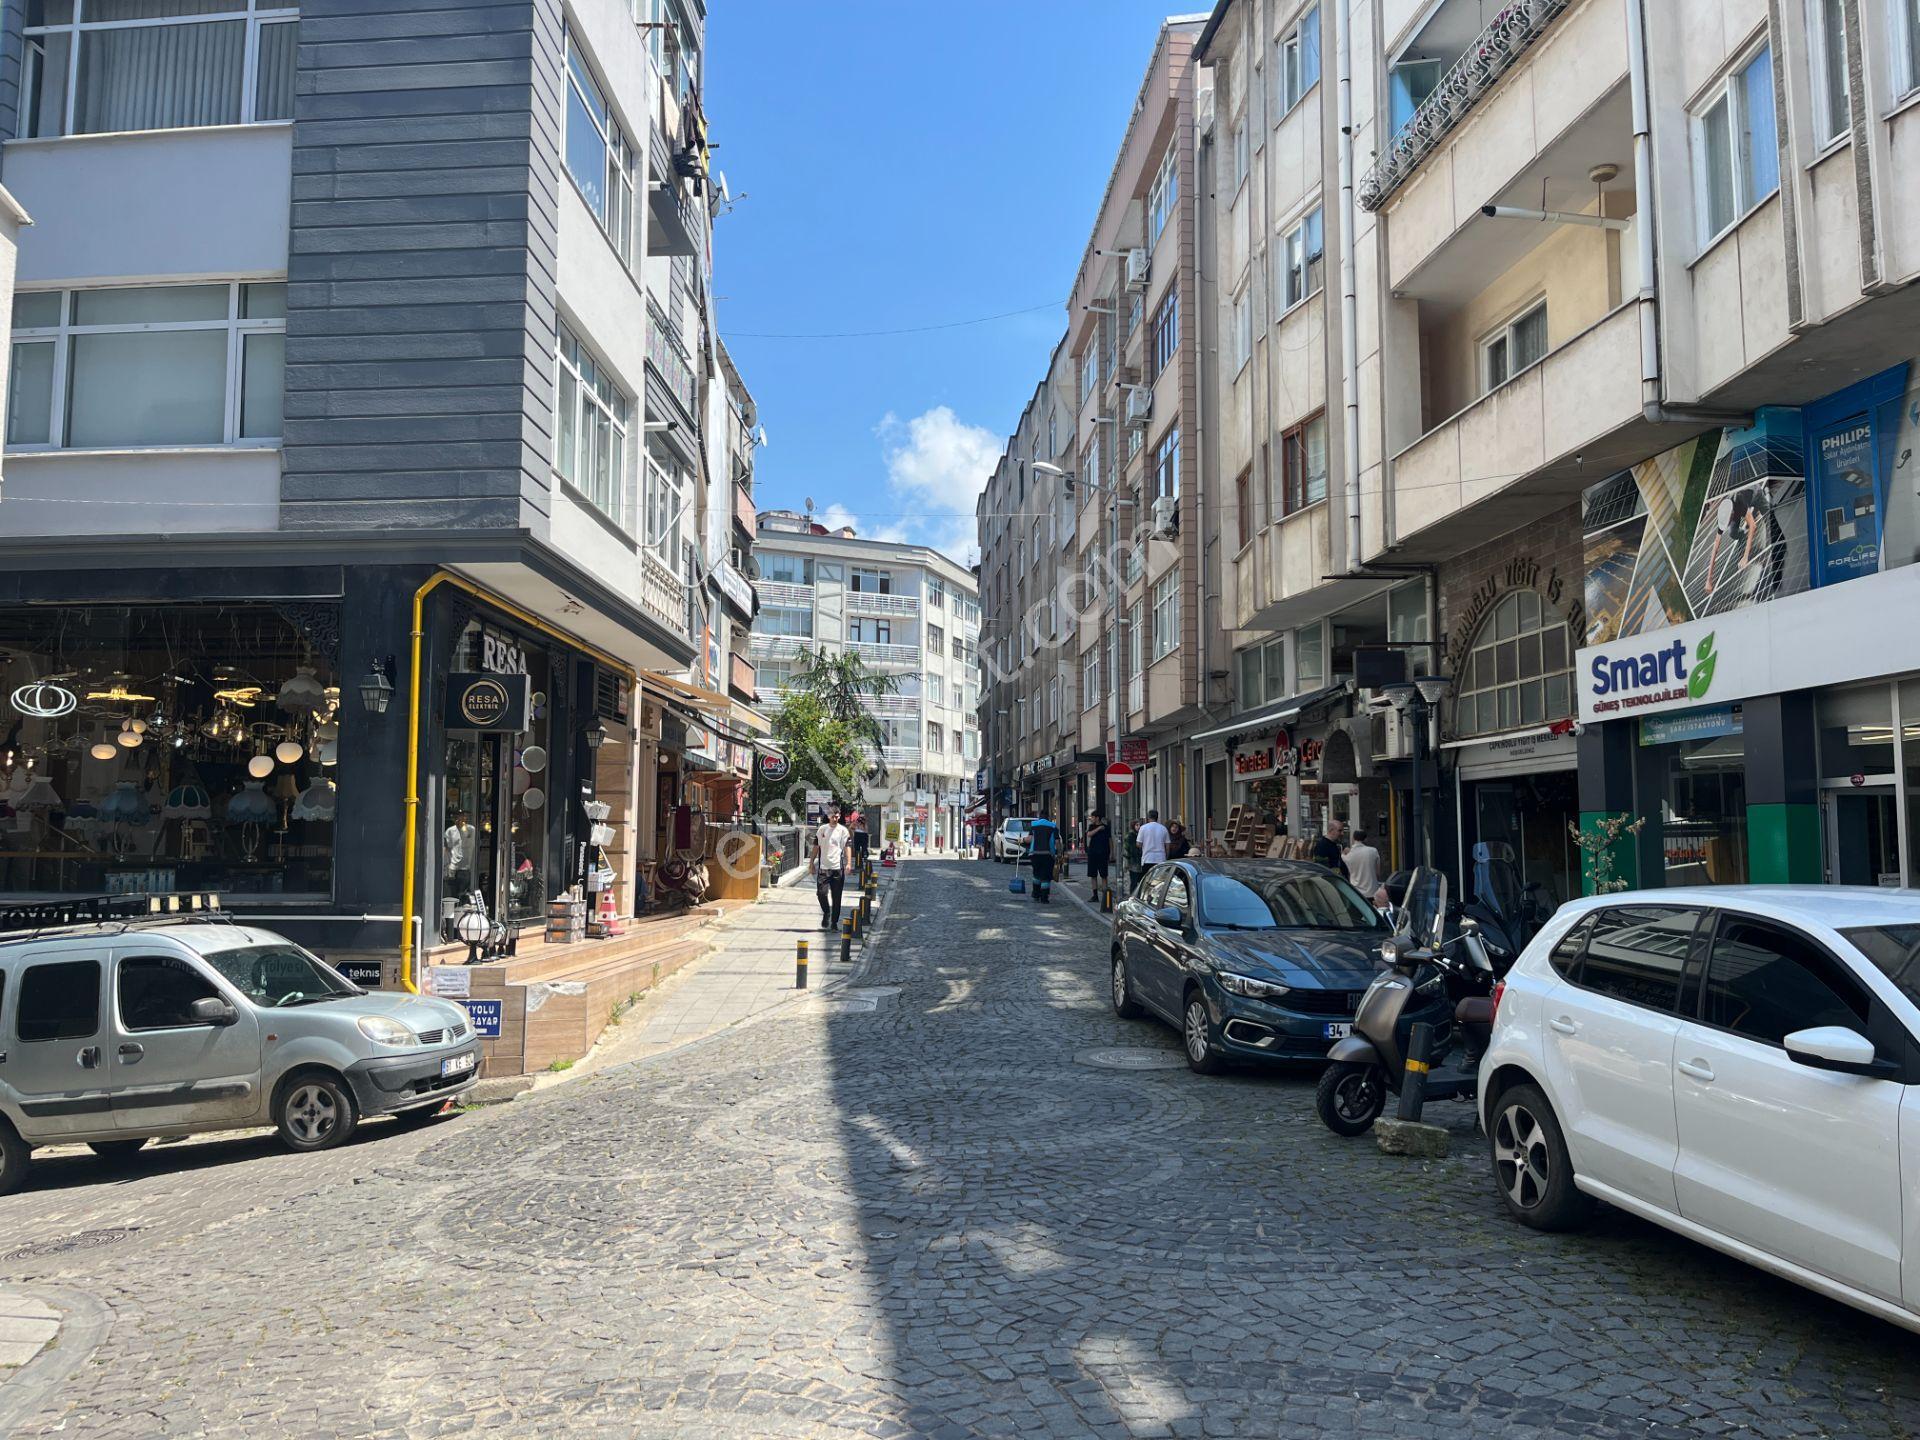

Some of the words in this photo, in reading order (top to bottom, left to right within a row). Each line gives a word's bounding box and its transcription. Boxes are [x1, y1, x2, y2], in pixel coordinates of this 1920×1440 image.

[1822, 425, 1871, 451] PHILIPS
[482, 634, 527, 674] RESA
[1591, 639, 1687, 694] Smart
[468, 695, 499, 703] RESA
[1593, 698, 1621, 713] GÜNEŞ
[1328, 1024, 1343, 1039] 34
